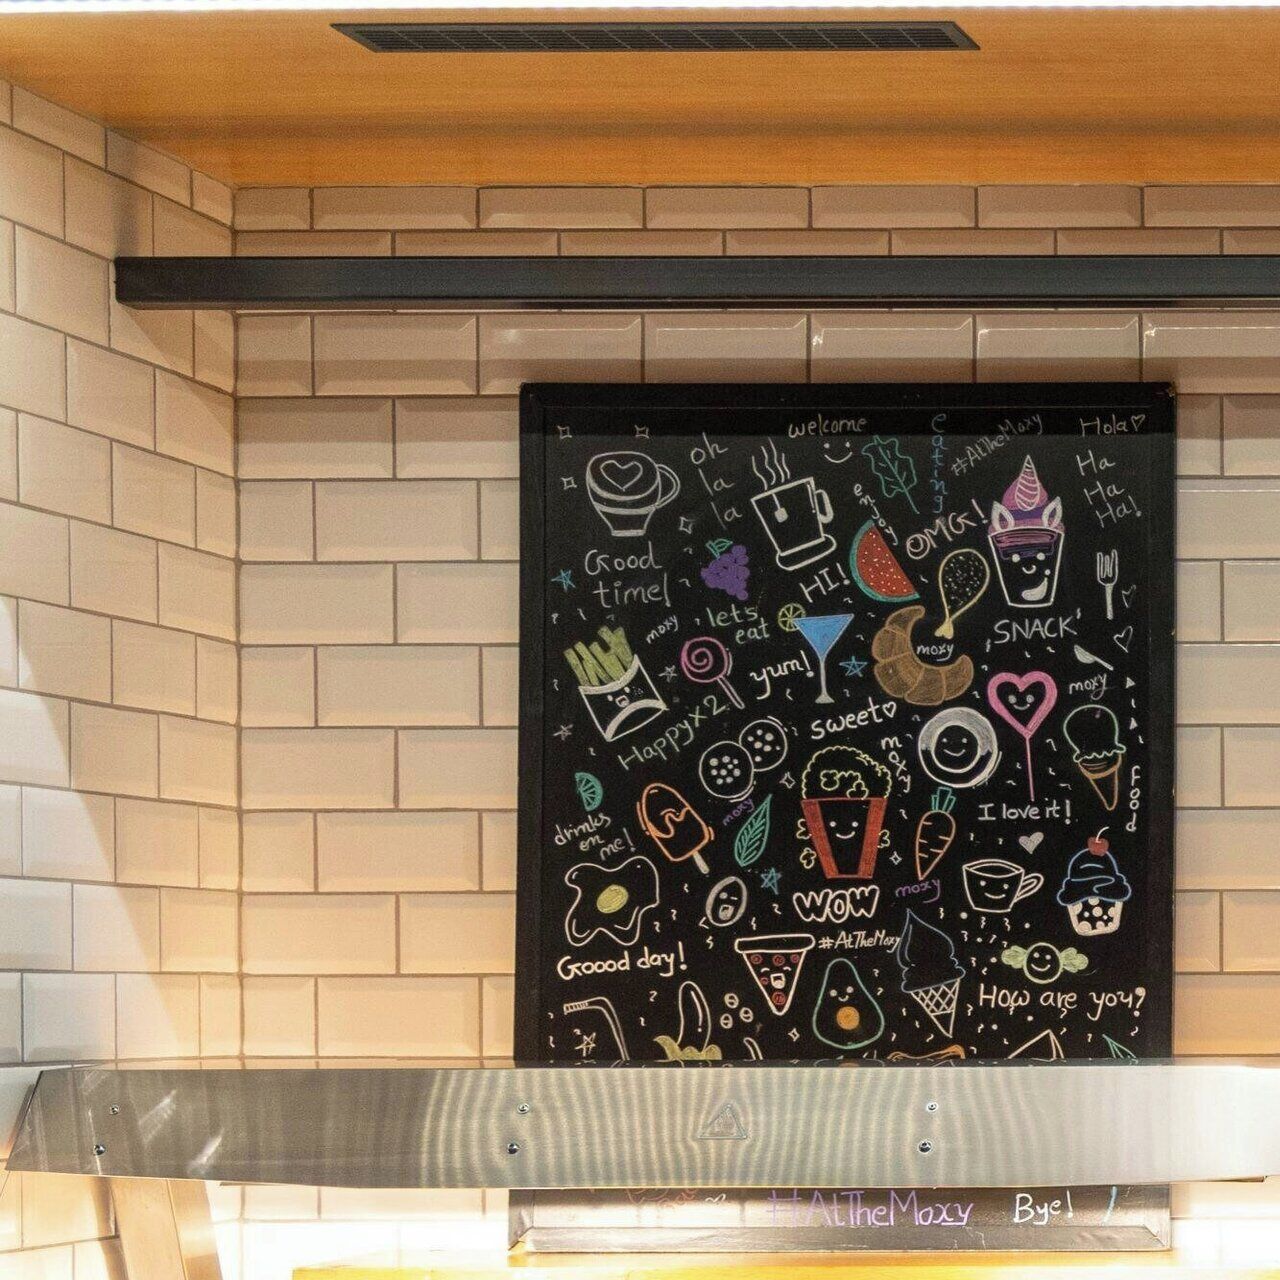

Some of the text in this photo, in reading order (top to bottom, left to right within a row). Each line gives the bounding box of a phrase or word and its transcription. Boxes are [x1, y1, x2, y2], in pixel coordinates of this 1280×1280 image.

[788, 414, 868, 438] welcome
[1080, 415, 1129, 437] Hola
[951, 414, 1044, 476] #AtTheMoxy
[1076, 450, 1116, 476] Ha
[698, 467, 734, 496] la
[1084, 481, 1125, 504] Ha
[710, 502, 742, 530] la
[853, 484, 899, 546] enjoy
[1096, 495, 1142, 528] Ha!
[906, 499, 988, 559] OMG!
[585, 540, 662, 576] Good
[593, 572, 671, 608] time!
[799, 563, 850, 603] HI!
[645, 615, 679, 643] moxy
[735, 617, 770, 645] eat
[916, 642, 954, 661] moxy
[750, 650, 814, 700] yum!
[1069, 674, 1108, 700] moxy
[811, 697, 883, 739] sweet
[881, 736, 911, 793] moxy
[722, 799, 755, 826] moxy
[978, 799, 1070, 825] I love it!
[554, 813, 611, 846] drinks
[580, 833, 606, 851] on
[599, 827, 636, 861] me!
[895, 879, 941, 903] moxy
[818, 929, 902, 953] #AtTheMoxy
[556, 941, 688, 980] Goood day!
[978, 984, 1146, 1021] How are you?
[766, 1188, 973, 1227] #AtTheMoxy
[1012, 1191, 1074, 1225] Bye!
